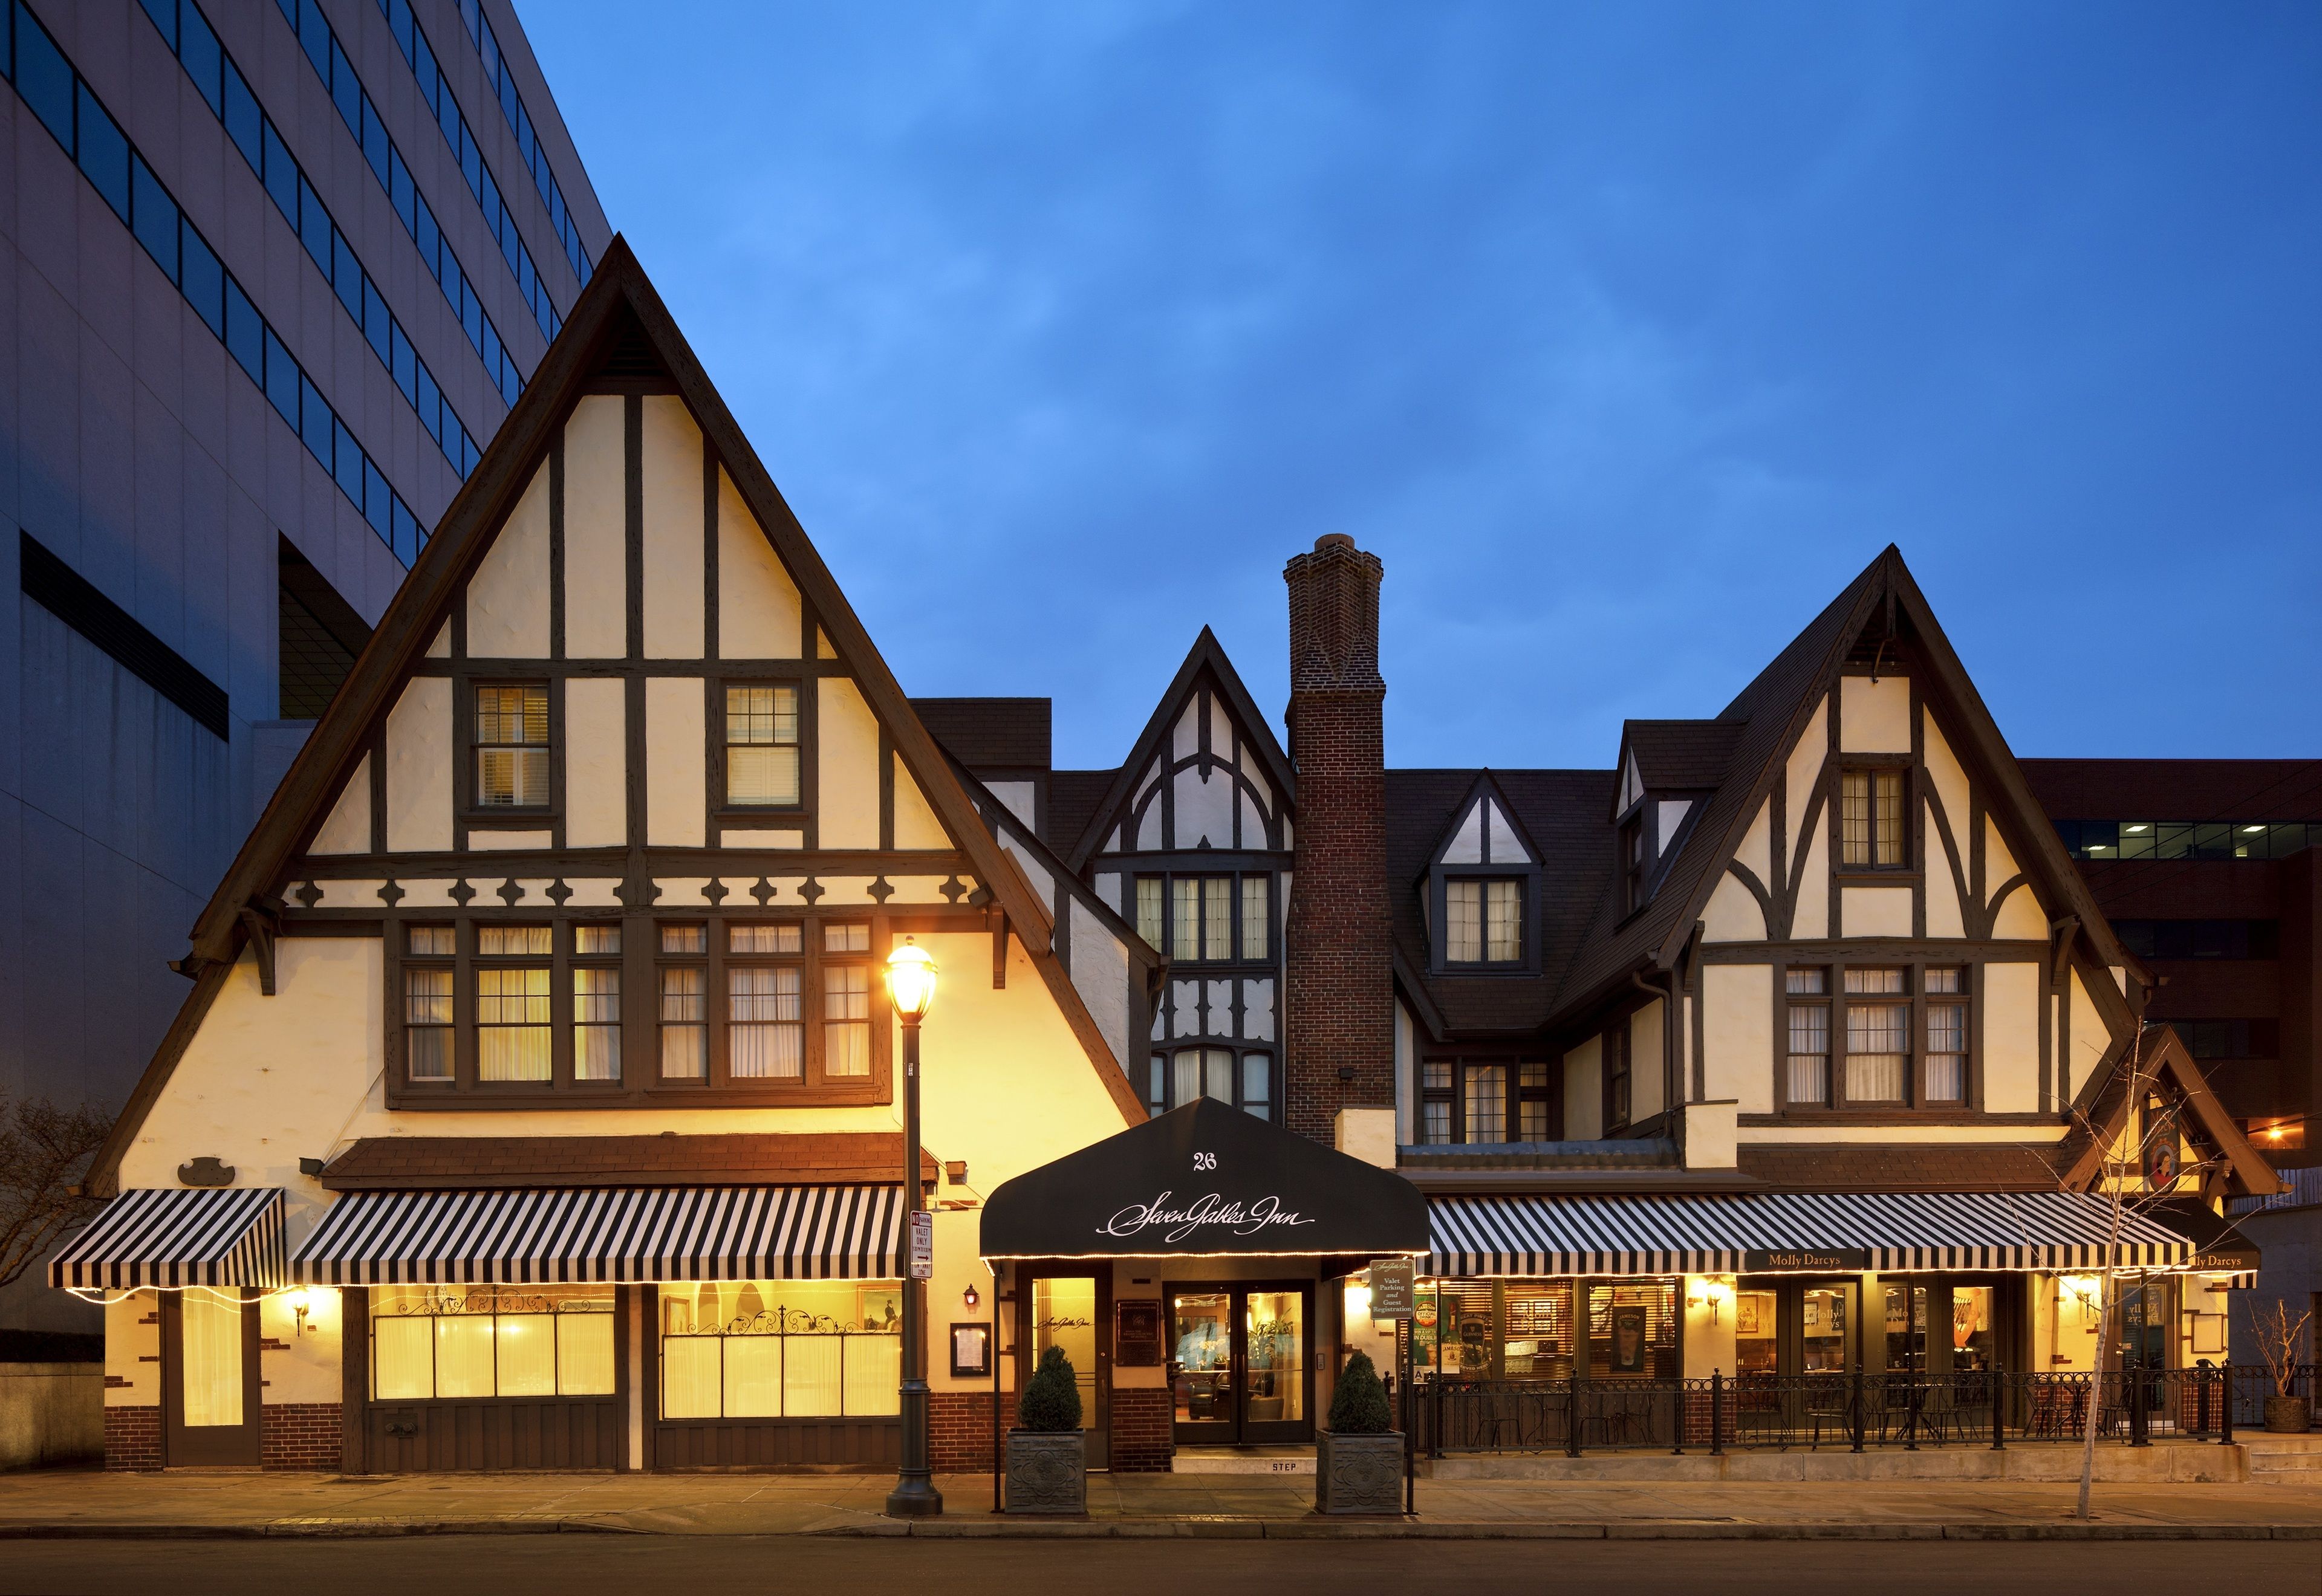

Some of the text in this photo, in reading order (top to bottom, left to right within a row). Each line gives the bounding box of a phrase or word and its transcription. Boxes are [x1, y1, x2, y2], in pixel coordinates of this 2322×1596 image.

[1193, 1152, 1217, 1170] 26
[912, 1214, 919, 1224] NO
[1096, 1191, 1315, 1243] Seven Gables Inn
[915, 1228, 928, 1236] VALET
[916, 1237, 927, 1245] ONLY
[1769, 1253, 1841, 1269] Molly Darcys
[2208, 1255, 2242, 1268] Darcys
